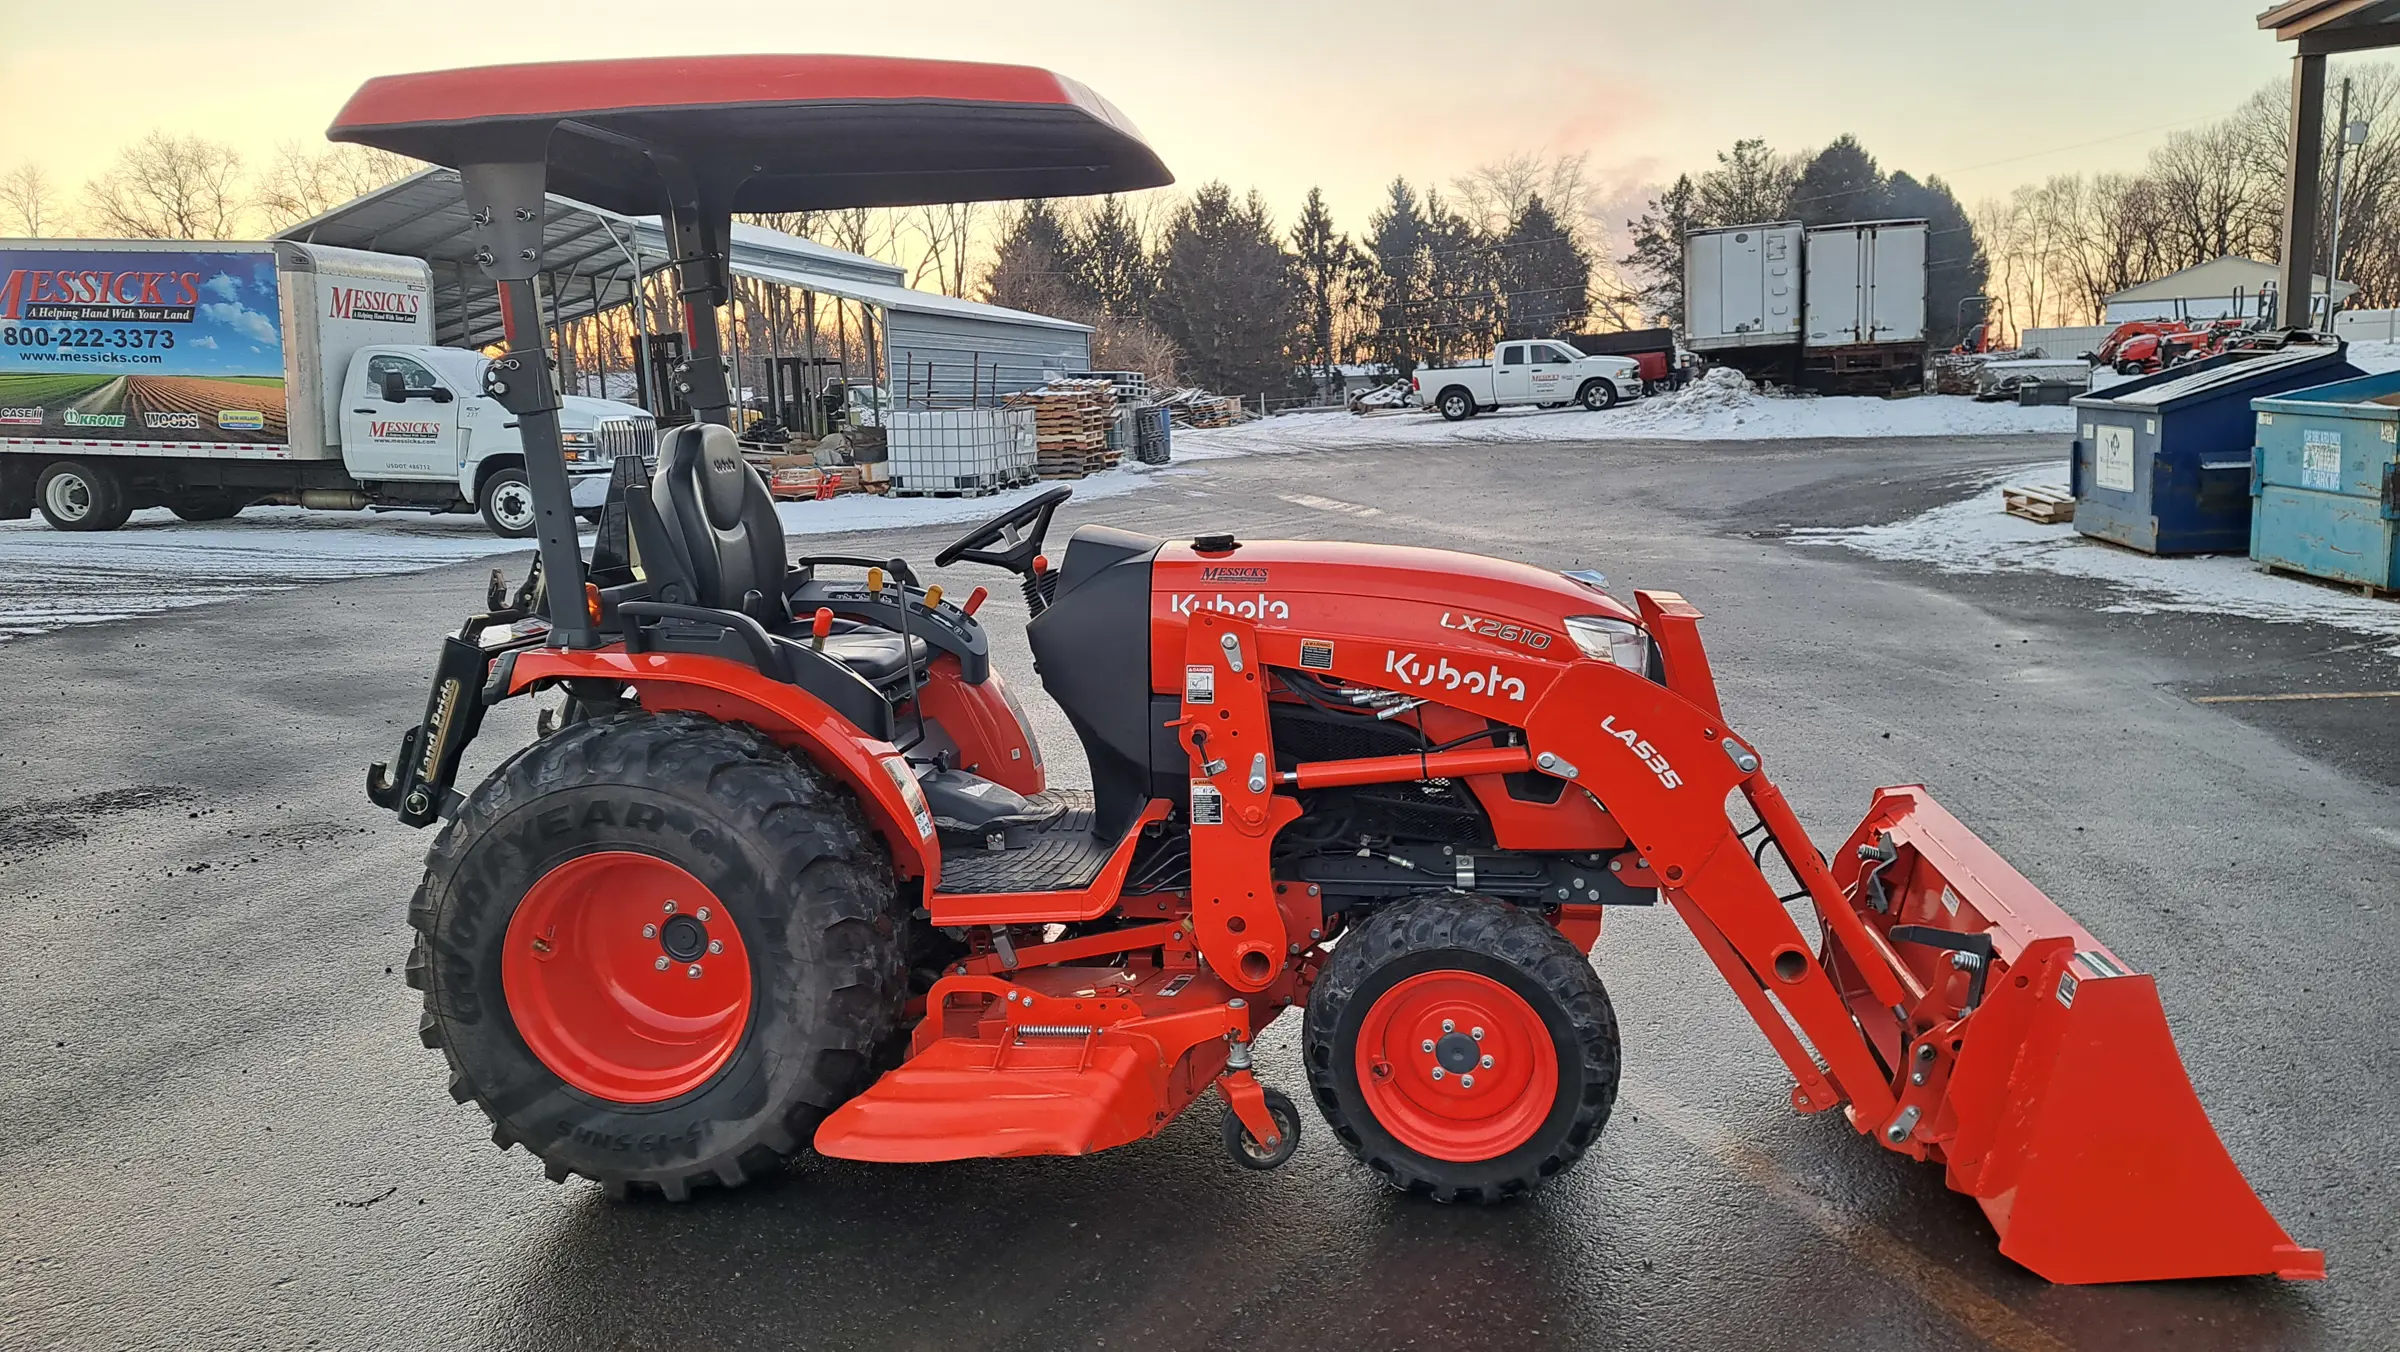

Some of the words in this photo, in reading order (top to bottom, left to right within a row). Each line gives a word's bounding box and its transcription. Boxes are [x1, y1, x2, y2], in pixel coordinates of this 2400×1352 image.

[329, 287, 419, 319] MESSICK'S
[28, 307, 37, 317] A
[38, 307, 78, 320] Helping
[80, 308, 110, 319] Hand
[112, 309, 135, 319] With
[138, 309, 161, 320] Your
[163, 310, 190, 320] Land
[3, 327, 175, 349] 800-222-3373
[19, 351, 162, 364] www.messicks.com
[2, 409, 33, 418] CASE
[80, 415, 125, 427] KRONE
[145, 413, 198, 428] WOODS
[368, 421, 440, 437] MESSICK'S
[1200, 567, 1269, 581] MESSICK'S
[1439, 612, 1552, 650] LX2610
[1385, 650, 1526, 701] Kubota
[416, 731, 438, 778] Land
[430, 679, 453, 728] Pride
[1600, 715, 1684, 790] LA535
